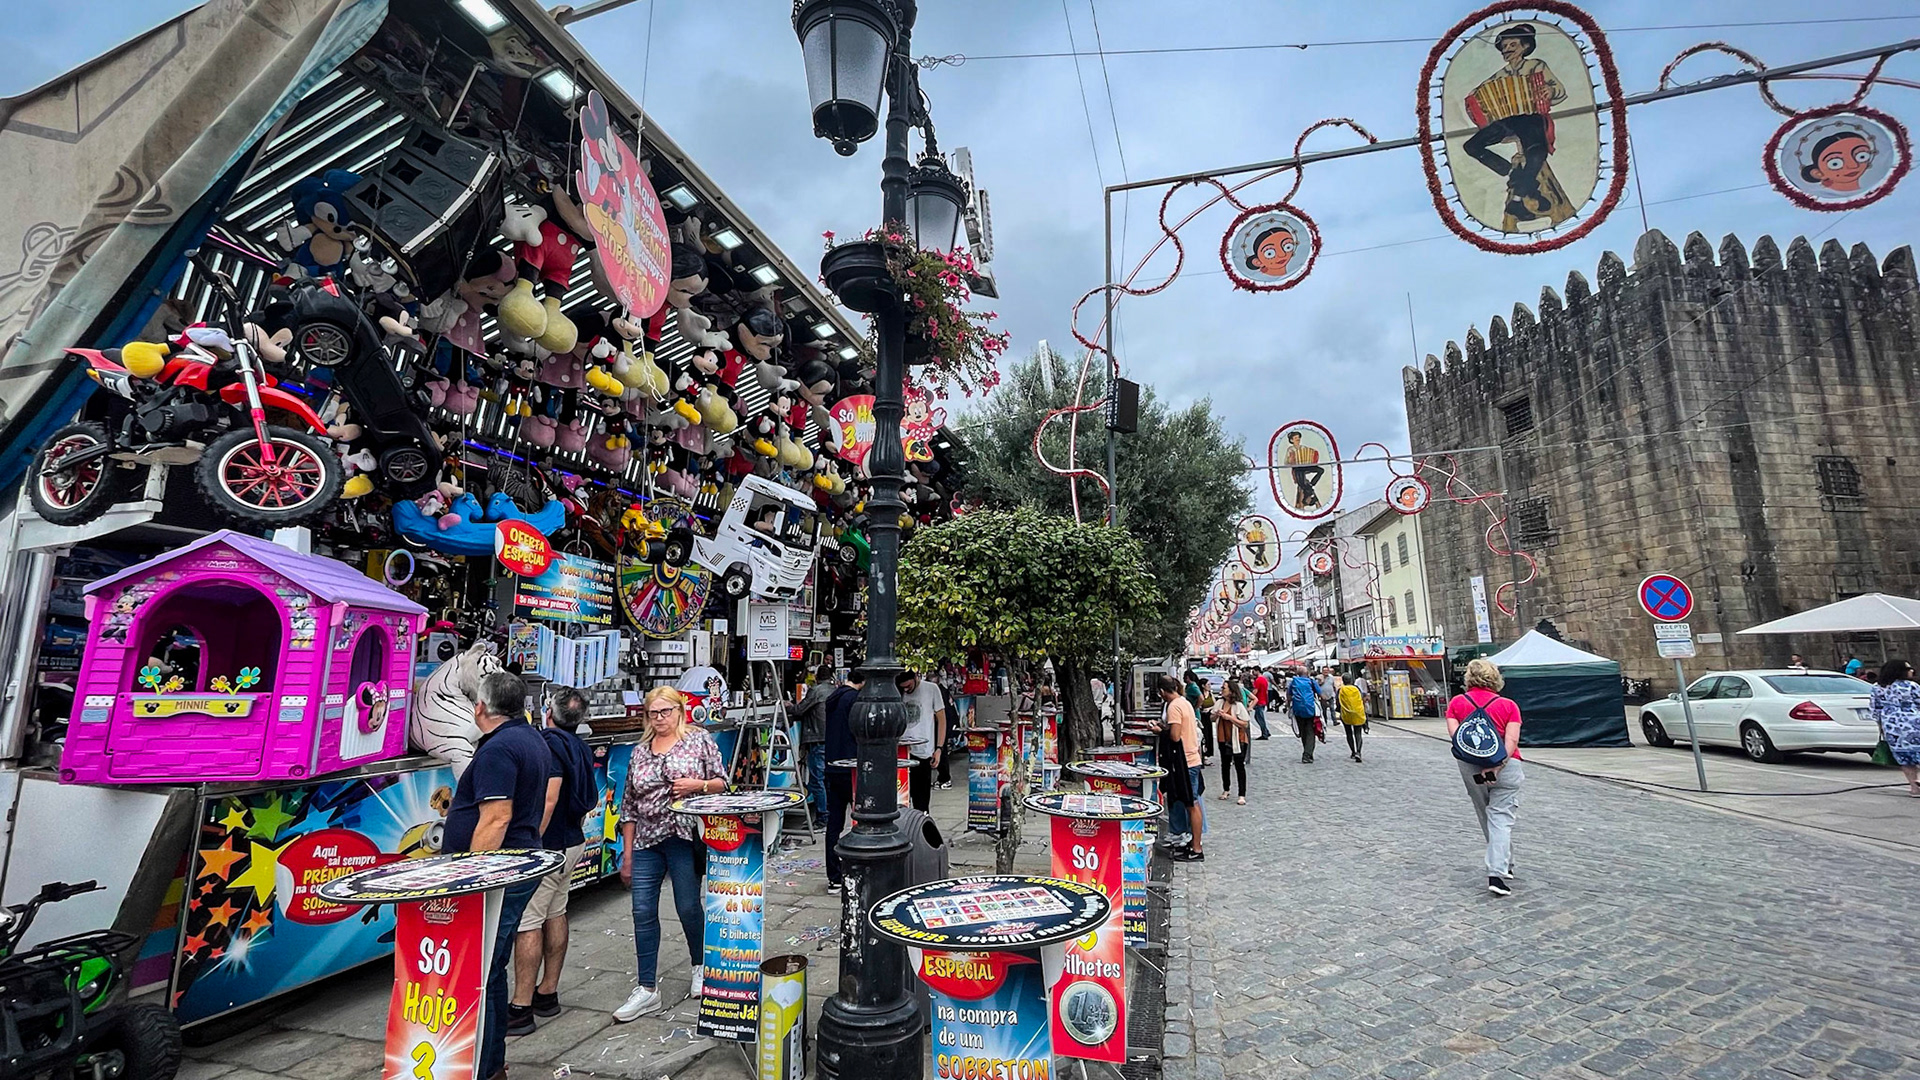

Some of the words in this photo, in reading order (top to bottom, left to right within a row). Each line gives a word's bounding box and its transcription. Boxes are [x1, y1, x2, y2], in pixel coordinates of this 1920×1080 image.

[634, 173, 656, 214] Aqui
[641, 206, 668, 248] sempre
[634, 212, 667, 270] PRÉMIO
[601, 225, 657, 306] SOBRETON
[839, 408, 855, 423] Só
[857, 403, 876, 423] Ho
[843, 425, 856, 450] 3
[510, 527, 545, 553] OFERTA
[503, 544, 546, 567] ESPECIAL
[760, 615, 778, 624] MB
[754, 642, 769, 650] MB
[1408, 637, 1440, 645] PIPOCAS
[175, 700, 210, 711] MINNIE
[1005, 735, 1011, 745] S
[1093, 778, 1122, 792] OFERTA
[707, 815, 739, 830] OFERTA
[705, 828, 740, 842] ESPECIAL
[312, 845, 339, 860] Aqui
[709, 853, 718, 863] na
[719, 855, 749, 867] compra
[1072, 844, 1100, 871] Só
[328, 857, 341, 867] sai
[342, 855, 377, 867] sempre
[586, 864, 599, 875] Já!
[709, 865, 717, 876] de
[719, 869, 730, 877] um
[295, 885, 307, 895] na
[708, 879, 763, 897] SOBRETON
[725, 899, 739, 913] de
[707, 912, 729, 925] oferta
[731, 915, 741, 925] de
[1131, 920, 1147, 933] Já!
[719, 928, 728, 940] 15
[729, 928, 761, 941] bilhetes
[418, 936, 452, 976] Só
[720, 945, 761, 962] PRÉMIO
[704, 965, 760, 984] GARANTIDO
[924, 955, 996, 981] ESPECIAL
[1065, 954, 1121, 979] ilhetes
[719, 989, 728, 997] sair
[402, 981, 458, 1034] Hoje
[703, 997, 740, 1010] devolveremos
[740, 1004, 759, 1021] Já!
[938, 1005, 956, 1022] na
[958, 1007, 1019, 1029] compra
[939, 1026, 956, 1046] de
[959, 1032, 984, 1049] um
[937, 1053, 1050, 1080] SOBRETON
